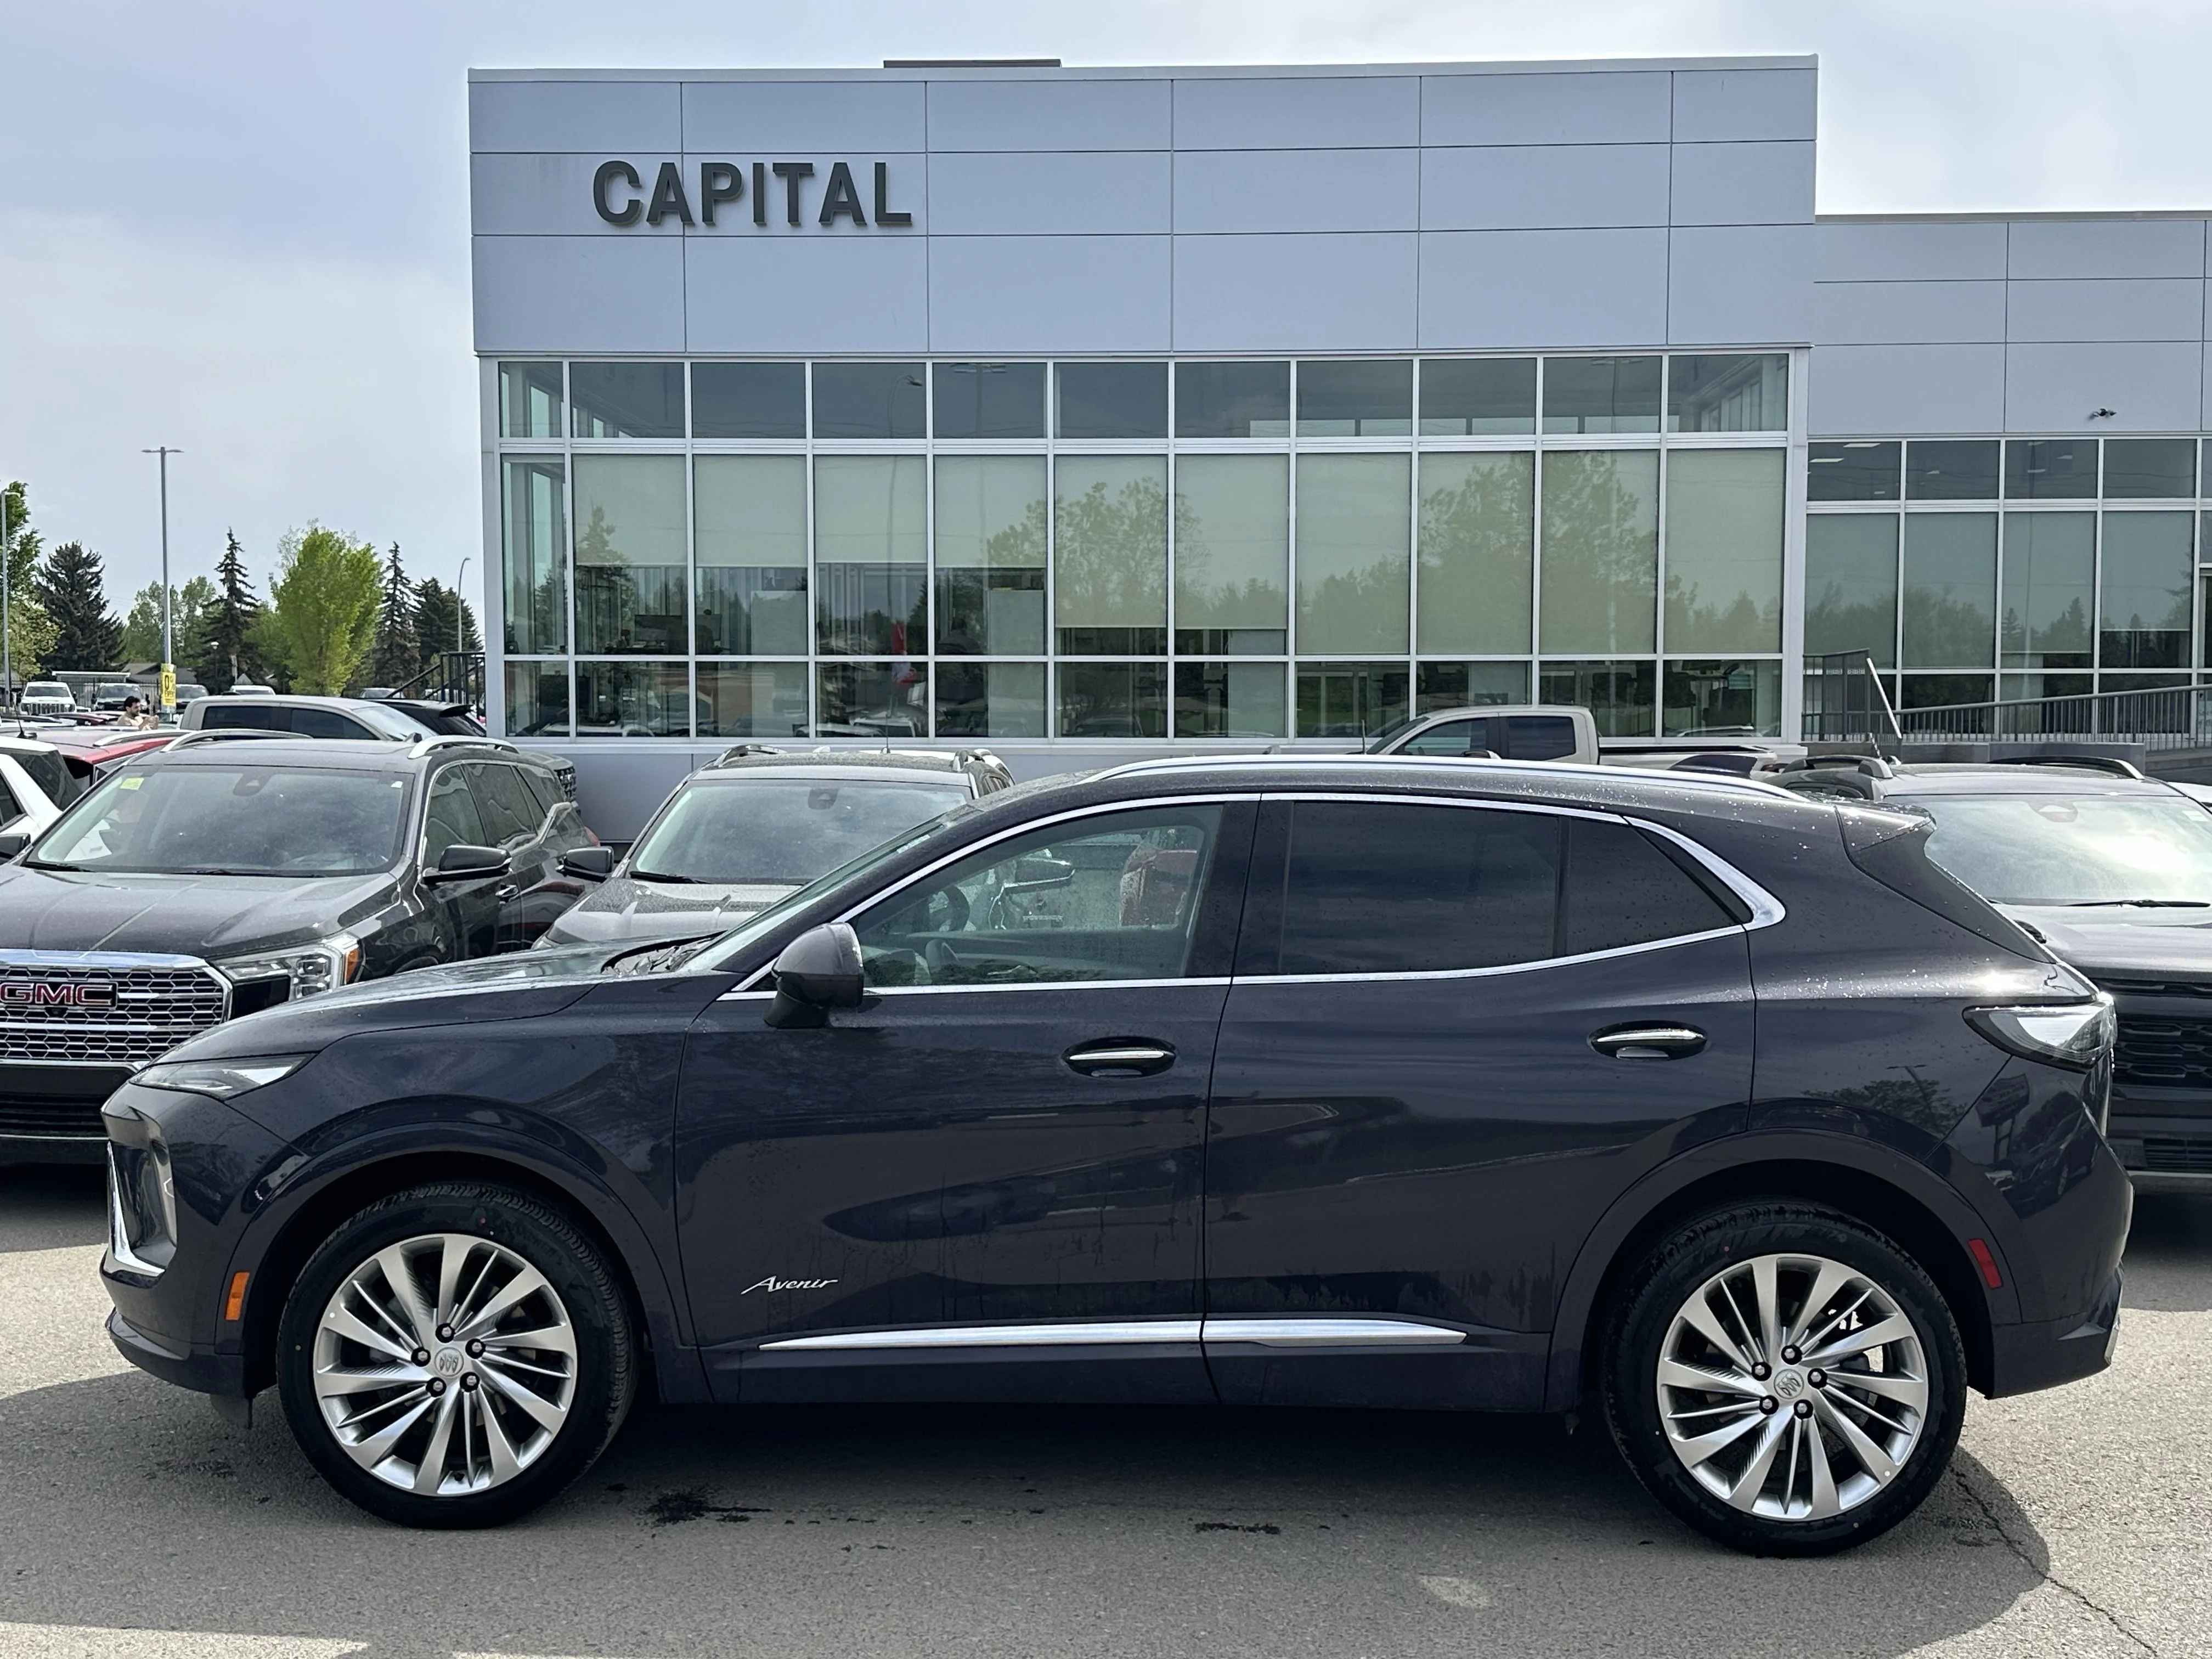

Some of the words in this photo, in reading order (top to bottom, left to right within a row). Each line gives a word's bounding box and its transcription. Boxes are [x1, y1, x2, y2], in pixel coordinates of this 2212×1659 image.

[593, 160, 912, 226] CAPITAL
[0, 983, 112, 1005] GMC
[741, 1276, 838, 1294] Avenir
